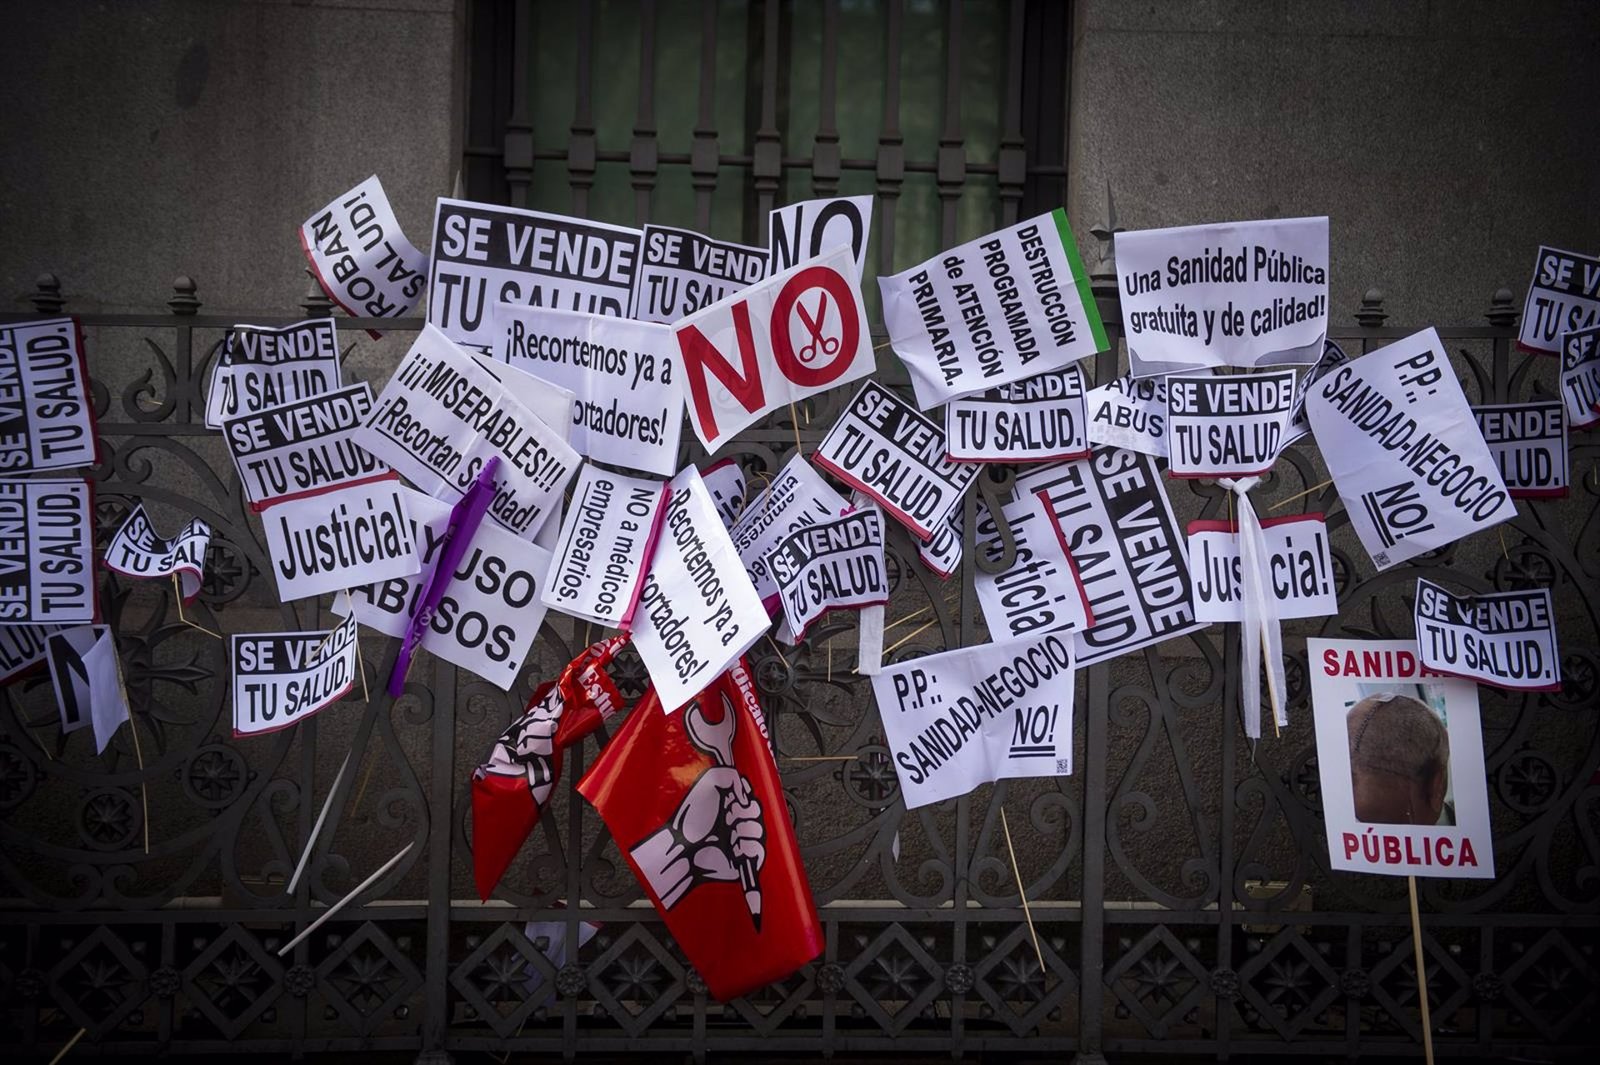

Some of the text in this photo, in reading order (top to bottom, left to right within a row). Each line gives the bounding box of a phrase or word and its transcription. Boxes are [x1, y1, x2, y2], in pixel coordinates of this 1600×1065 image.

[343, 191, 428, 298] SALUD!
[442, 214, 635, 284] SE VENDE
[647, 232, 769, 284] SE VEND
[943, 255, 966, 280] de
[1125, 245, 1326, 297] Una Sanidad Pública
[1541, 254, 1575, 291] SE
[438, 273, 488, 332] TU
[648, 275, 679, 316] TU
[979, 238, 1041, 366] PROGRAMADA
[1017, 224, 1077, 347] DESTRUCCIÓN
[241, 326, 334, 363] VENDE
[908, 269, 964, 387] PRIMARIA.
[953, 283, 1005, 379] ATENCIÓN
[1130, 294, 1326, 346] gratuita y de calidad!
[1533, 297, 1563, 342] TU
[505, 319, 672, 391] ¡Recortemos ya a
[676, 265, 860, 444] NO
[26, 327, 85, 460] TU SALUD.
[857, 390, 897, 430] SE
[1171, 382, 1199, 414] SE
[1205, 378, 1292, 414] VENDE
[231, 391, 372, 455] SE VENDE
[365, 395, 463, 477] ¡Recortan
[956, 407, 1082, 452] TU SALUD.
[1175, 421, 1281, 466] TU SALUD
[1322, 367, 1507, 523] SANIDAD-NEGOCIO
[247, 455, 288, 498] TU
[626, 487, 656, 518] NO
[831, 424, 874, 471] TU
[861, 448, 943, 529] SALUD.
[128, 515, 155, 552] SE
[279, 492, 412, 581] Justicia!
[620, 520, 639, 532] a
[1374, 480, 1436, 540] NO!
[37, 487, 85, 614] TU SALUD.
[120, 543, 152, 573] TU
[557, 479, 615, 603] empresarios.
[773, 545, 800, 584] SE
[794, 515, 882, 560] VENDE
[1095, 449, 1194, 634] SE VENDE
[1197, 532, 1329, 603] Juscia!
[0, 584, 28, 619] SE
[594, 535, 635, 616] médicos
[788, 579, 809, 624] TU
[807, 554, 887, 606] SALUD.
[703, 597, 734, 632] ya
[722, 623, 740, 647] a
[1420, 587, 1549, 632] SE VENDE
[239, 640, 275, 672] SE
[284, 615, 355, 671] VENDE
[1323, 648, 1440, 678] SANID
[1426, 624, 1551, 680] TU SALUD.
[244, 655, 349, 723] TU SALUD.
[896, 635, 1069, 785] SANIDAD-NEGOCIO
[1011, 704, 1059, 746] NO!
[1342, 827, 1478, 867] PÚBLICA
